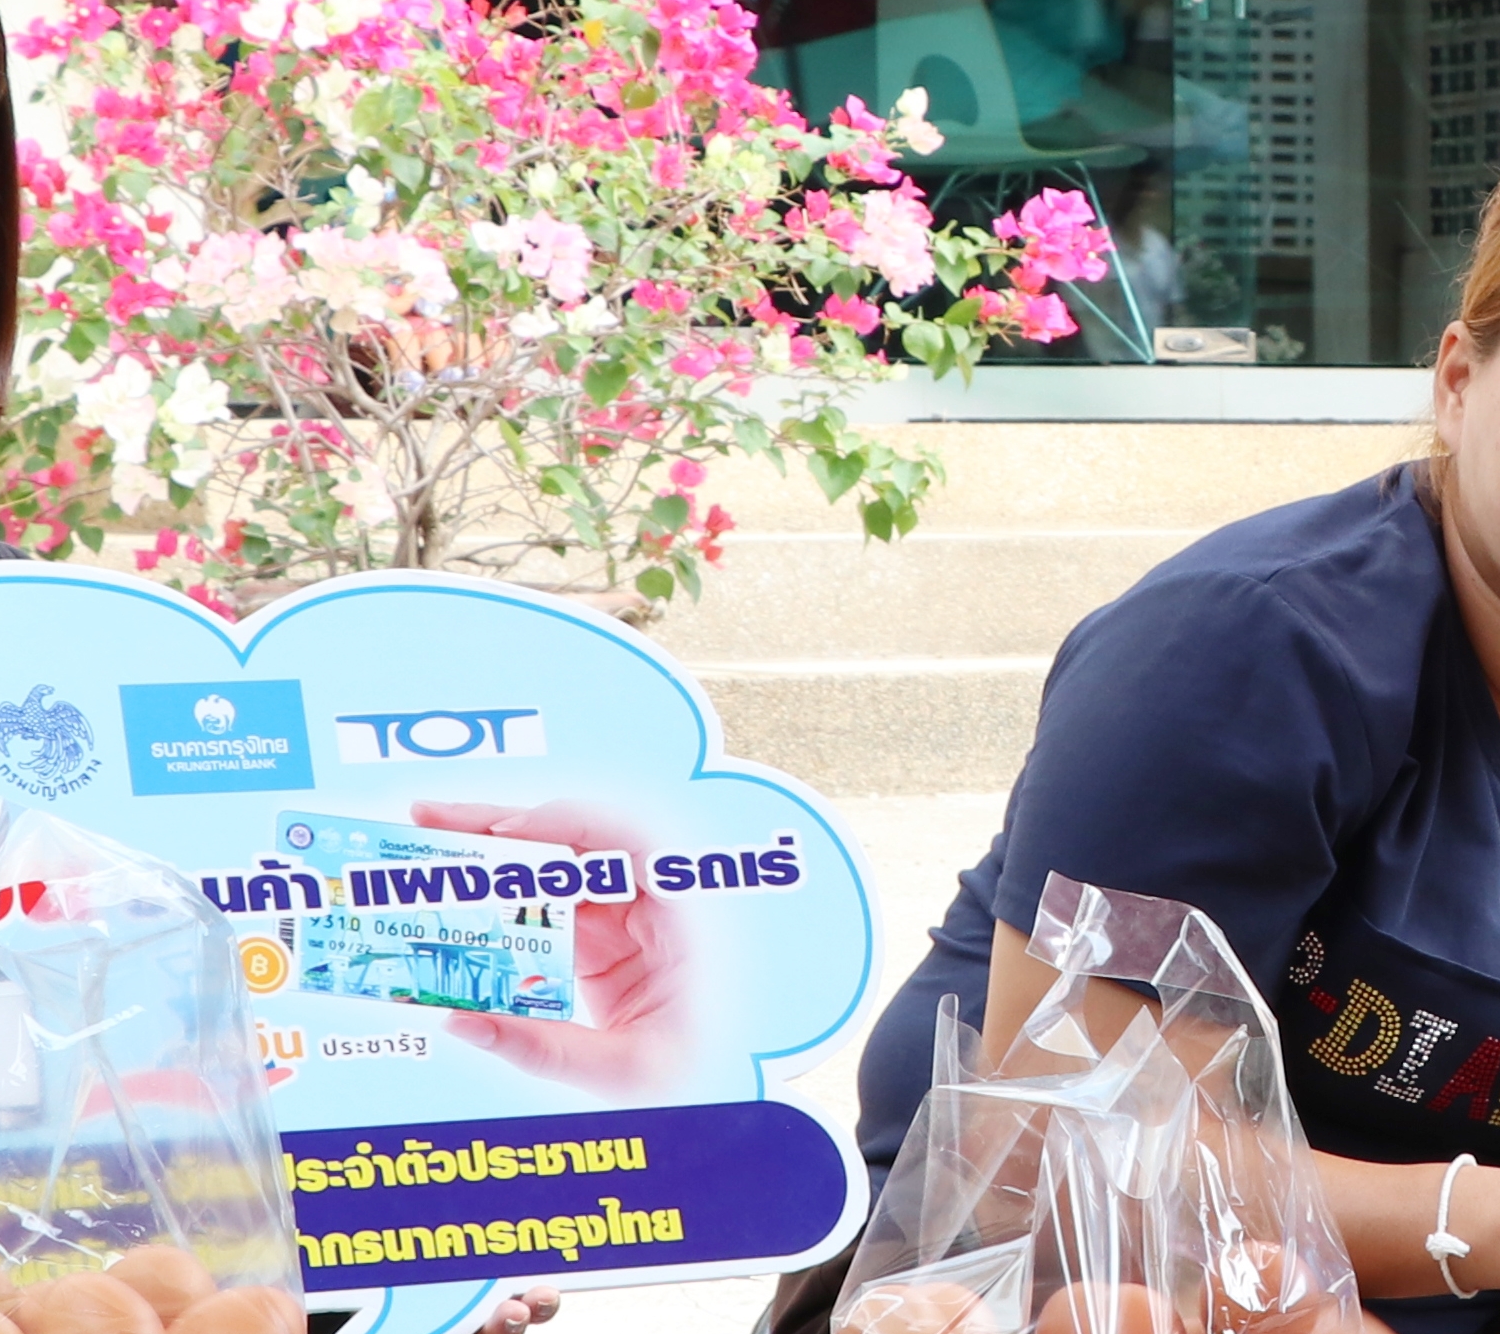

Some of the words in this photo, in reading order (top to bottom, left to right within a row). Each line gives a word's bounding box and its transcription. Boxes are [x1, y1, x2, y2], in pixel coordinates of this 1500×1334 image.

[151, 734, 290, 761] ธนาคารกรุงไทย
[335, 708, 540, 759] TOT
[166, 760, 240, 773] KRUNGTHAI
[242, 759, 277, 772] BANK
[199, 858, 322, 915] นค้า
[350, 856, 628, 907] แผงลอย
[653, 836, 801, 893] รถเร่
[374, 920, 426, 939] 0600
[438, 927, 489, 947] 0000
[502, 935, 552, 955] 0000
[322, 1032, 428, 1060] ประชารัฐ
[298, 1198, 684, 1269] ากธนาคารกรุงไทย
